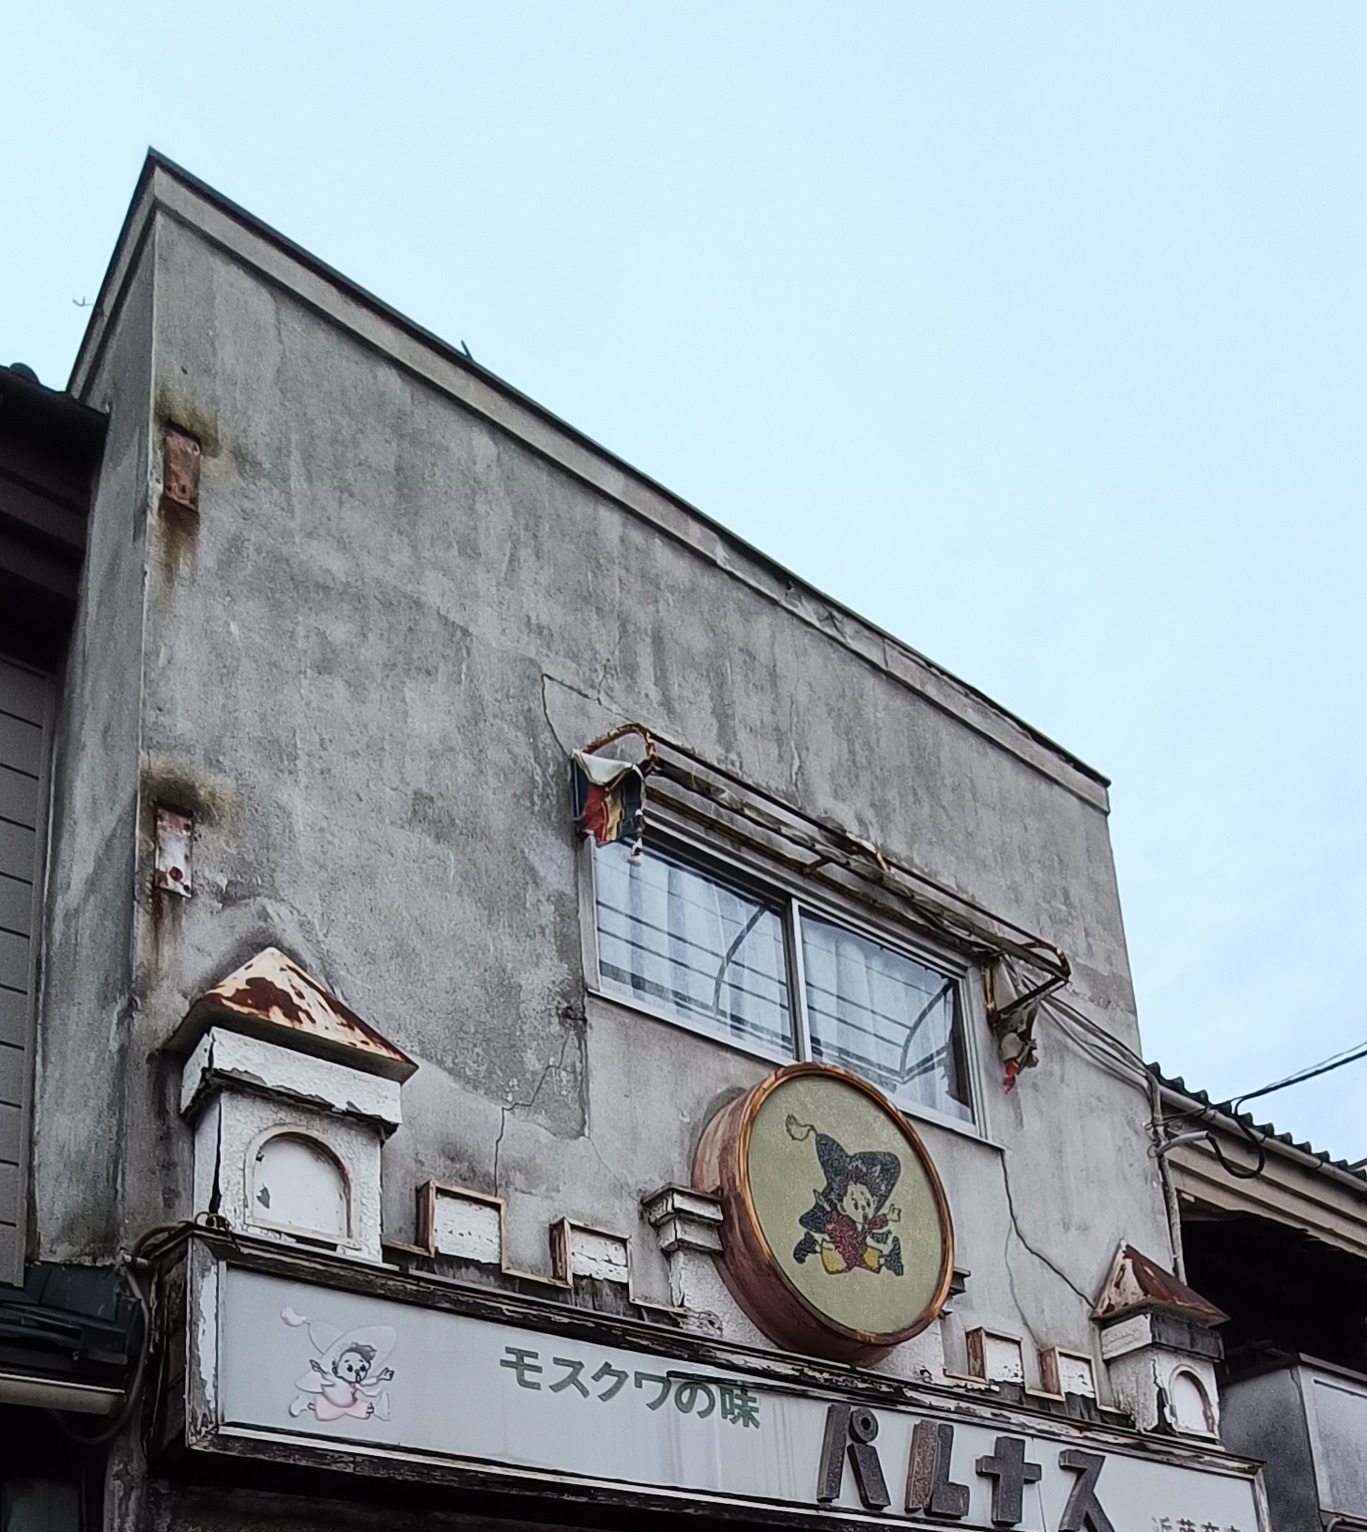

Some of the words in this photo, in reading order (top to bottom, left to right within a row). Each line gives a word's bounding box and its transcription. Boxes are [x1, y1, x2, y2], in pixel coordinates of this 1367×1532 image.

[499, 1345, 761, 1429] モスクワの味
